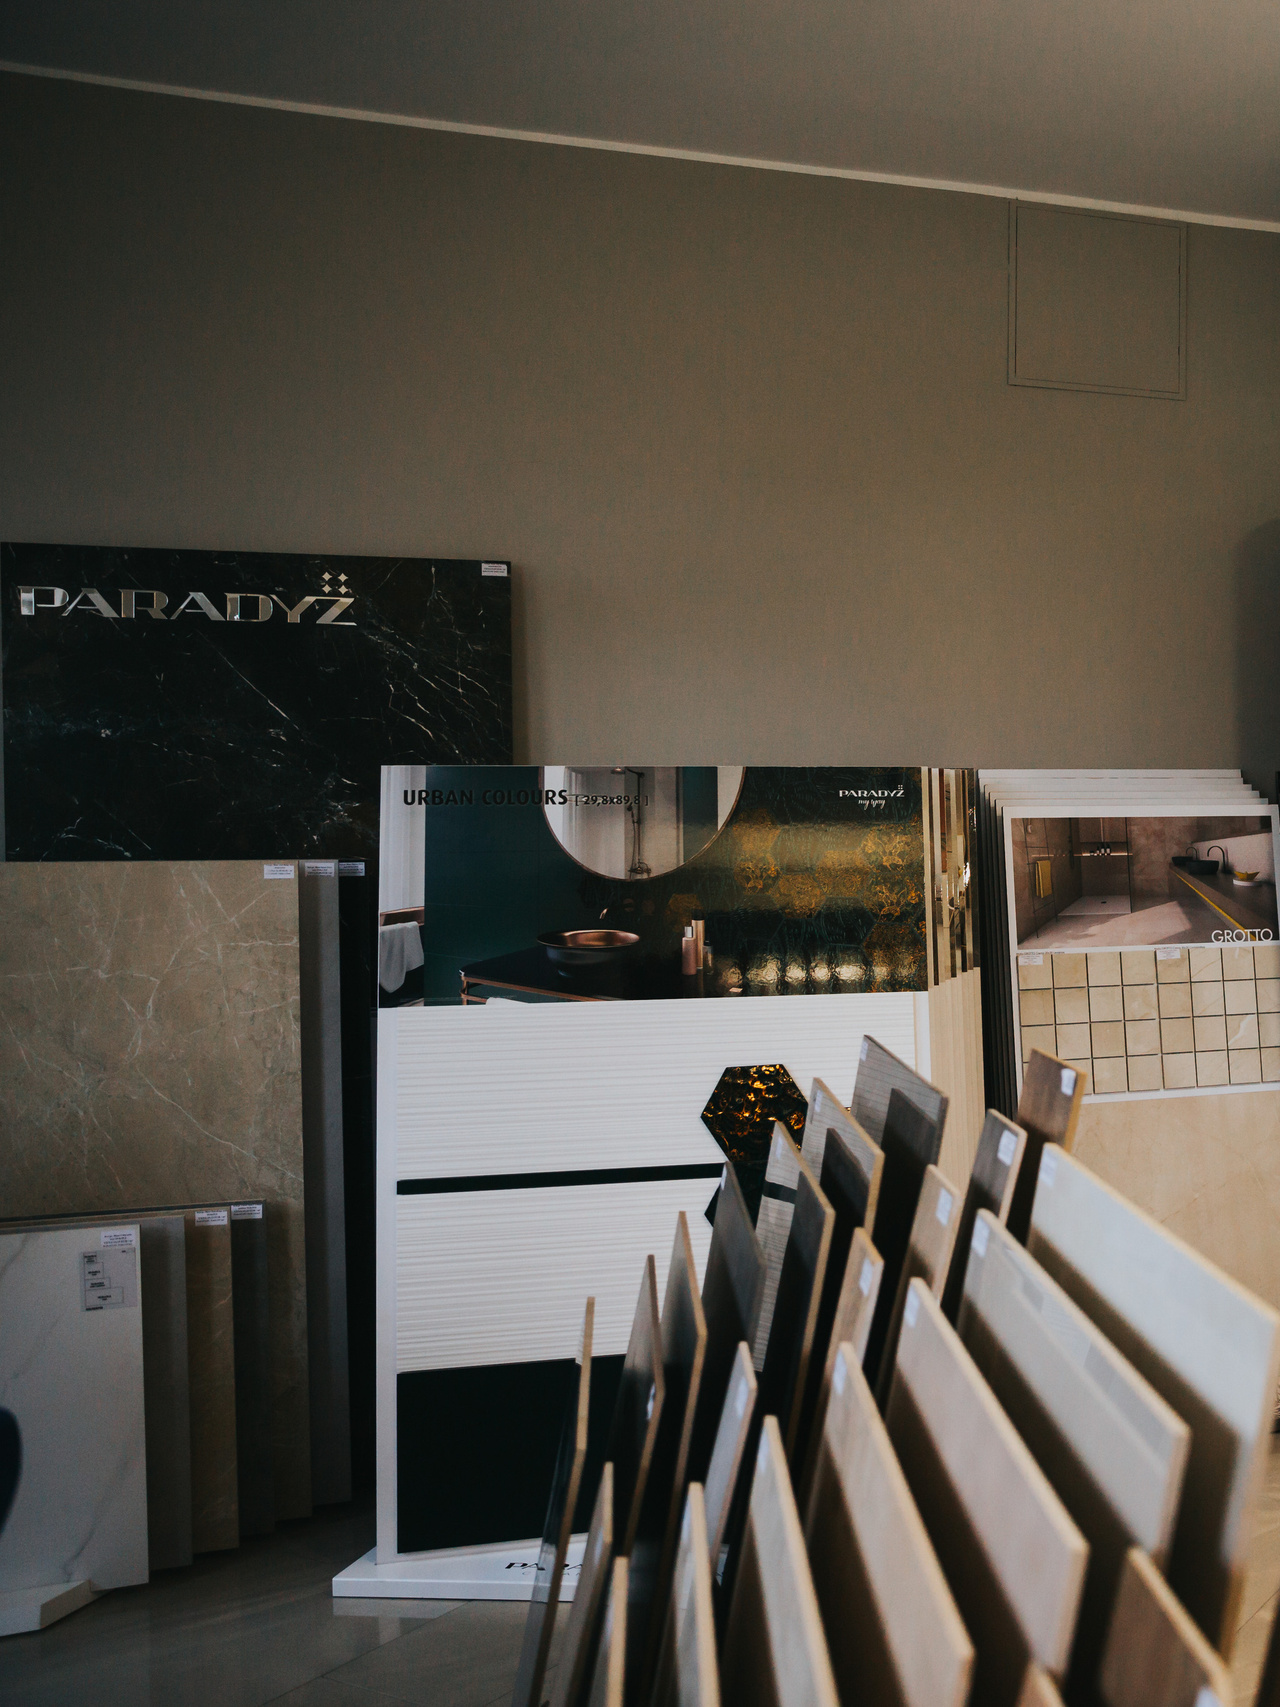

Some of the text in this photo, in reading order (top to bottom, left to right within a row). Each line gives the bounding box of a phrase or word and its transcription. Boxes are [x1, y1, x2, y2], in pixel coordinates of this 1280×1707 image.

[403, 789, 474, 806] URBAN
[482, 789, 569, 806] COLOURS
[583, 795, 641, 806] 29,8x89,8
[1211, 928, 1273, 944] GROTTO
